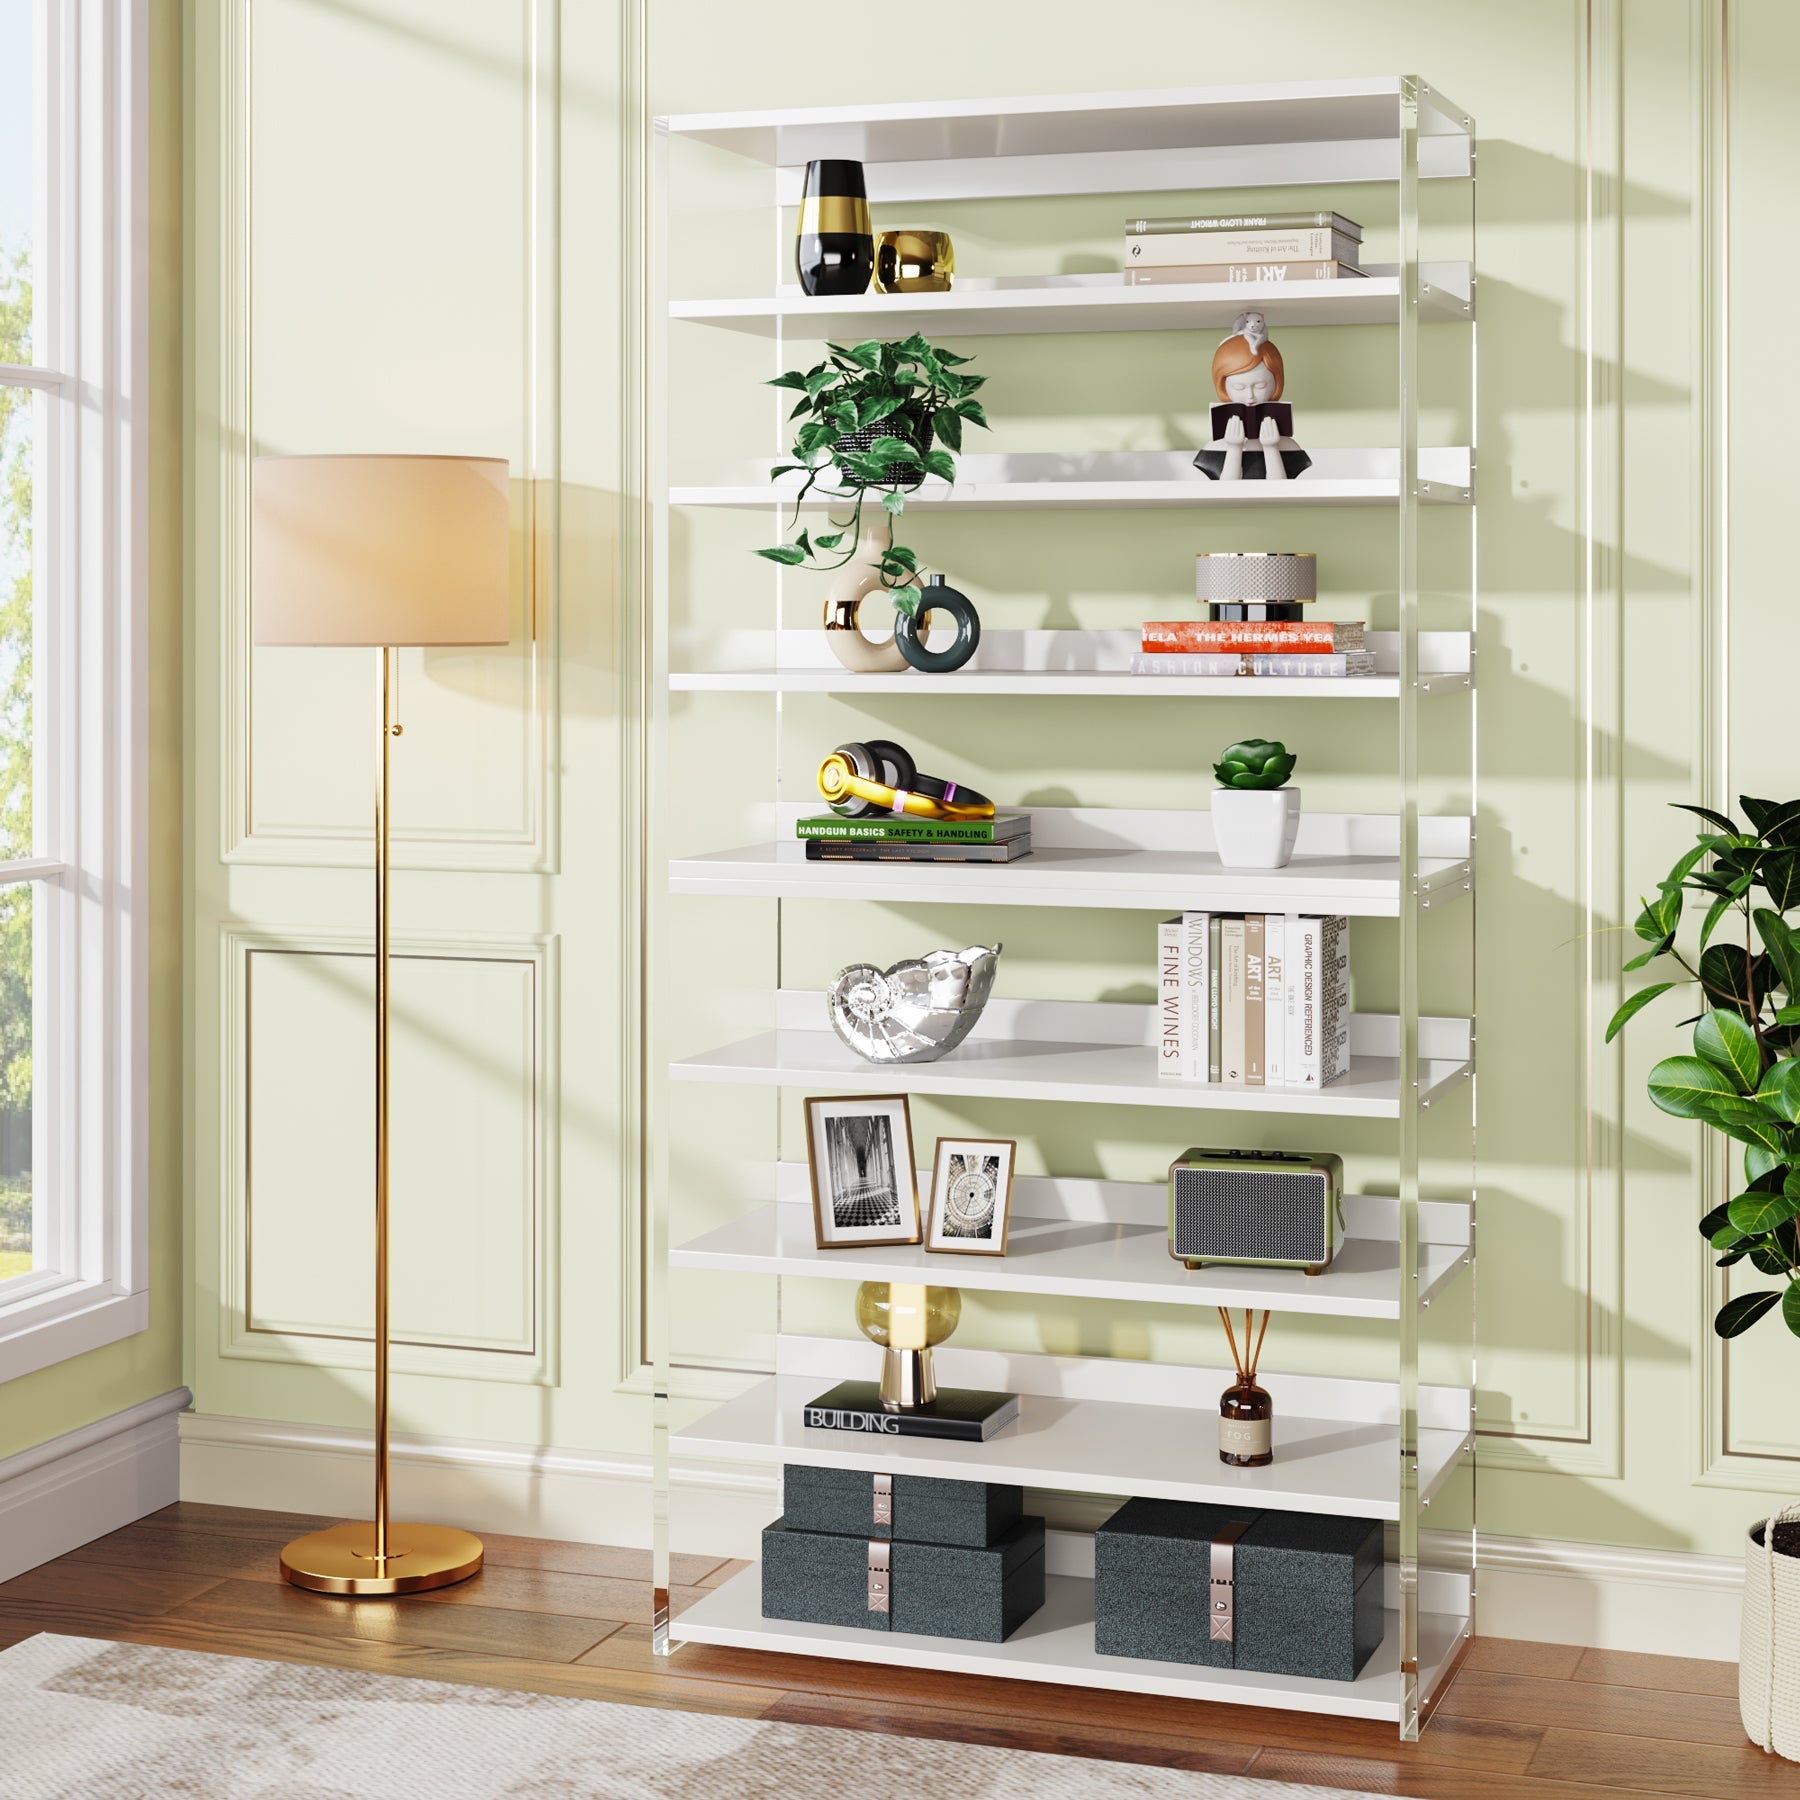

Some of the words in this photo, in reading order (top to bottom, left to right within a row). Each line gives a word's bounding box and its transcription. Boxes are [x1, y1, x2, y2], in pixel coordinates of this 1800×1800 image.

[1190, 219, 1219, 229] WRIGHT
[1220, 218, 1243, 227] LLOYD
[1244, 217, 1267, 226] FRANK
[1194, 632, 1226, 642] THE
[1238, 661, 1338, 676] CULTURE
[798, 826, 847, 836] HANDGUN
[849, 827, 885, 837] BASICS
[888, 828, 924, 838] SAFETY
[926, 829, 933, 838] &
[937, 829, 988, 839] HANDLING
[1188, 917, 1203, 987] WINDOWS
[1304, 933, 1313, 970] GRAPHIC
[1163, 945, 1179, 987] FINE
[1247, 954, 1262, 982] ART
[1268, 955, 1281, 982] ART
[1304, 971, 1313, 1001] DESIGN
[1163, 996, 1179, 1058] WINES
[1304, 1003, 1313, 1056] REFERENCED
[810, 1409, 900, 1434] BUILDING
